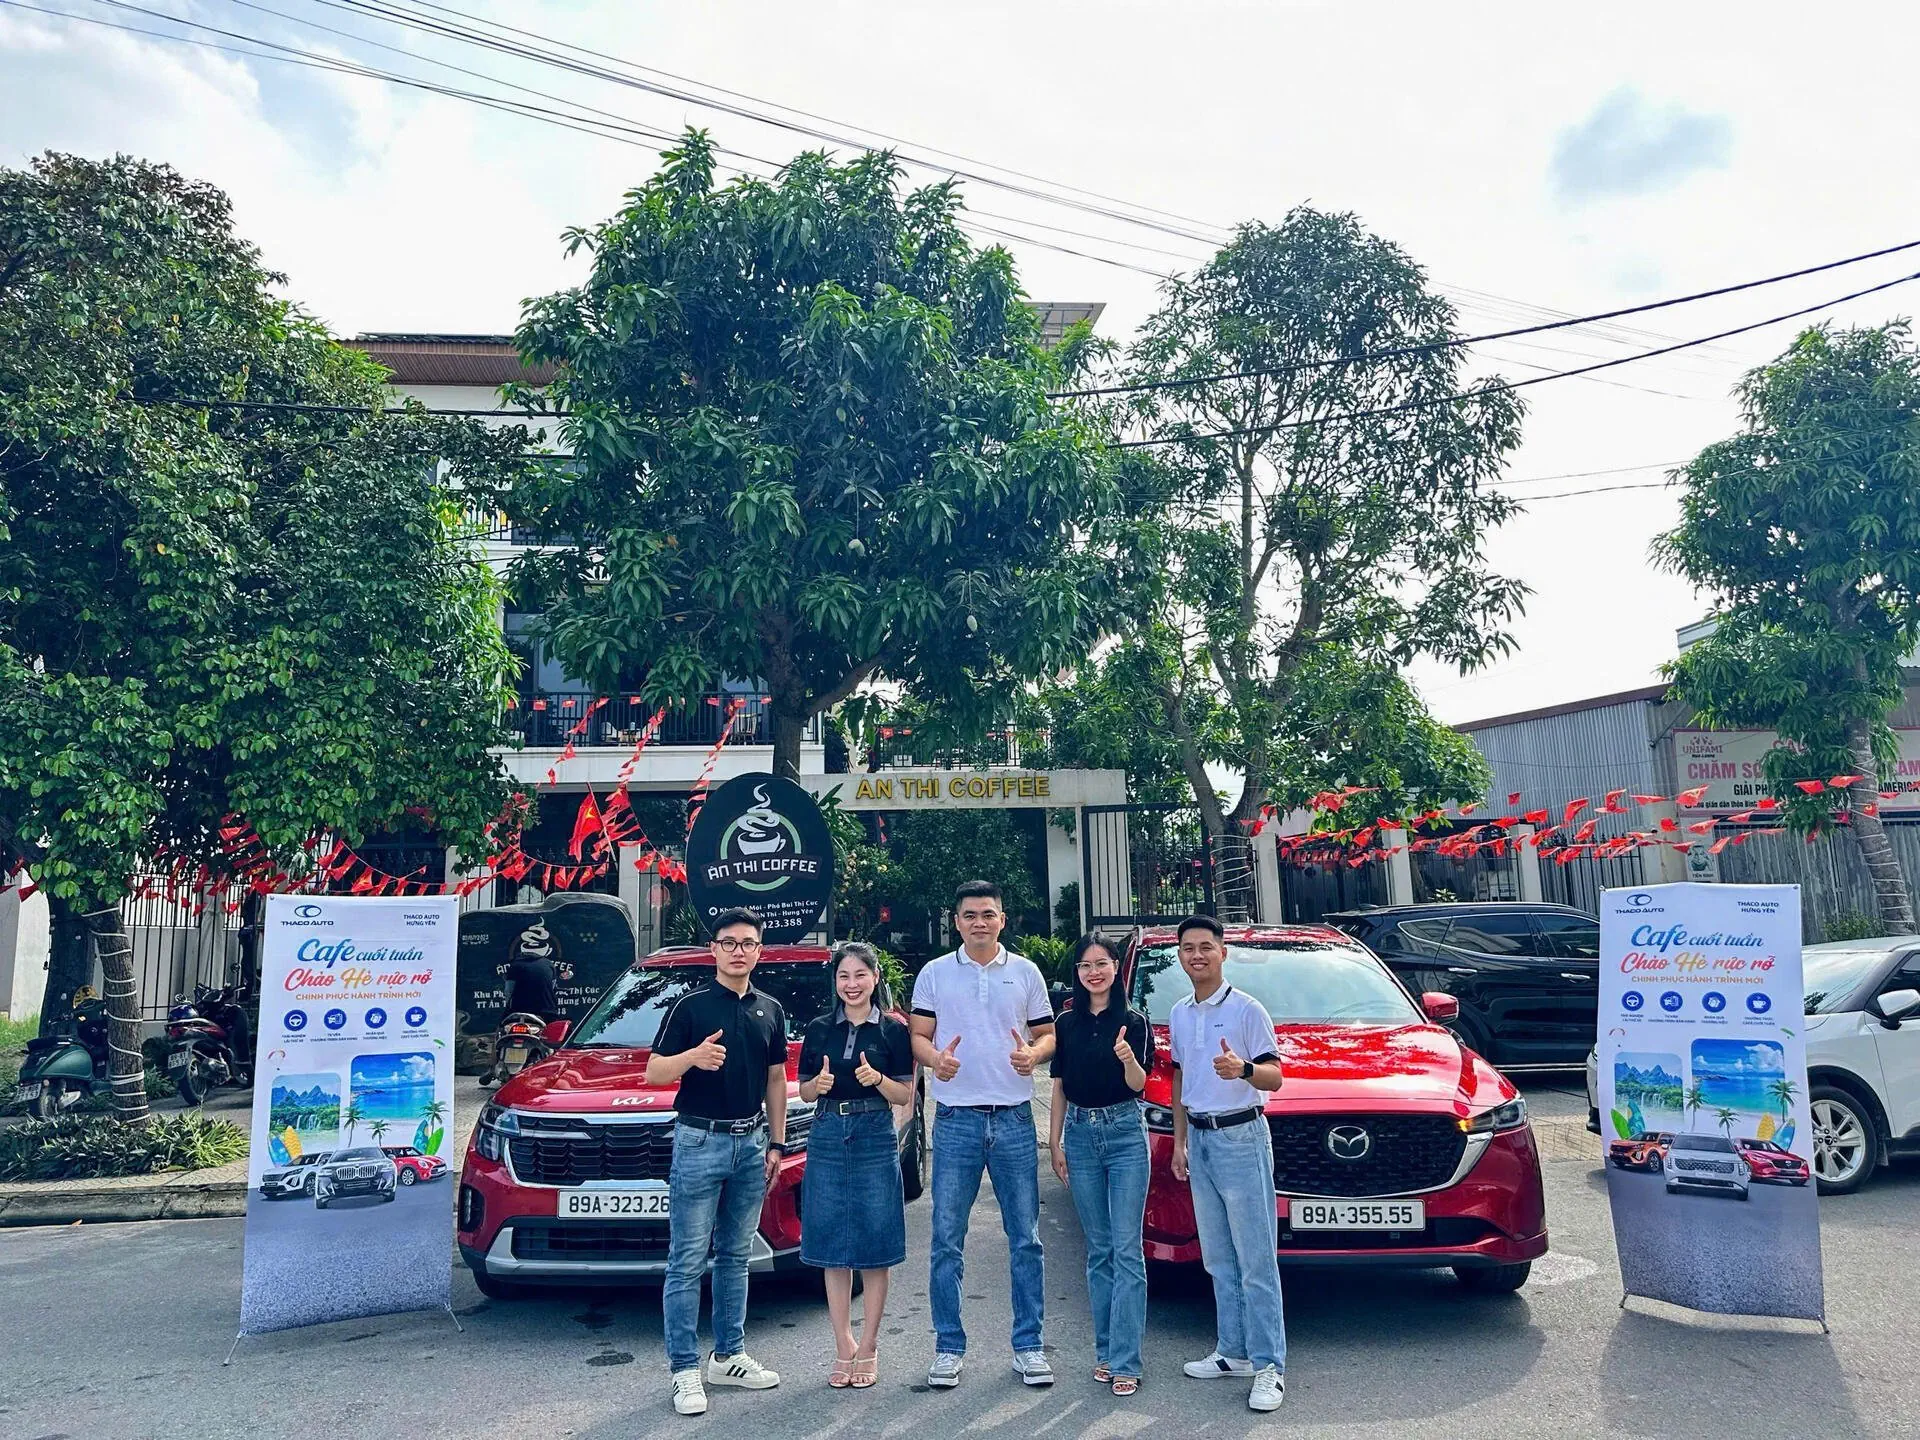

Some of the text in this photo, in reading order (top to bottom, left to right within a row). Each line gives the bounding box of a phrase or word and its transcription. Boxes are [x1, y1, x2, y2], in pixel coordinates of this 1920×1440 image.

[1687, 759, 1765, 779] CHĂM SÓ
[900, 777, 940, 799] THI
[949, 776, 1051, 799] COFFEE
[1755, 784, 1769, 796] PH
[733, 860, 758, 874] THI
[761, 859, 818, 873] COFFEE
[761, 917, 803, 930] 423.388
[1630, 924, 1765, 953] Cafe cuối tuần
[297, 938, 424, 968] Cafe cuối tuần
[1712, 956, 1748, 974] rực
[1750, 955, 1776, 971] rỡ
[376, 970, 408, 989] rực
[410, 968, 433, 986] rỡ
[1660, 975, 1686, 984] PHỤC
[1686, 974, 1714, 984] HÀNH
[1714, 975, 1744, 984] TRÌNH
[1745, 975, 1764, 985] MỚI
[325, 993, 350, 1001] PHỤC
[351, 991, 376, 1000] HÀNH
[377, 990, 404, 1000] TRÌNH
[405, 991, 422, 999] MỚI
[473, 991, 491, 999] Khu
[493, 990, 505, 999] Ph
[570, 986, 583, 995] Thị
[585, 986, 601, 995] Cúc
[557, 997, 580, 1006] Hưng
[568, 1195, 670, 1214] 89A-323.26
[1302, 1206, 1413, 1225] 89A-355.55
